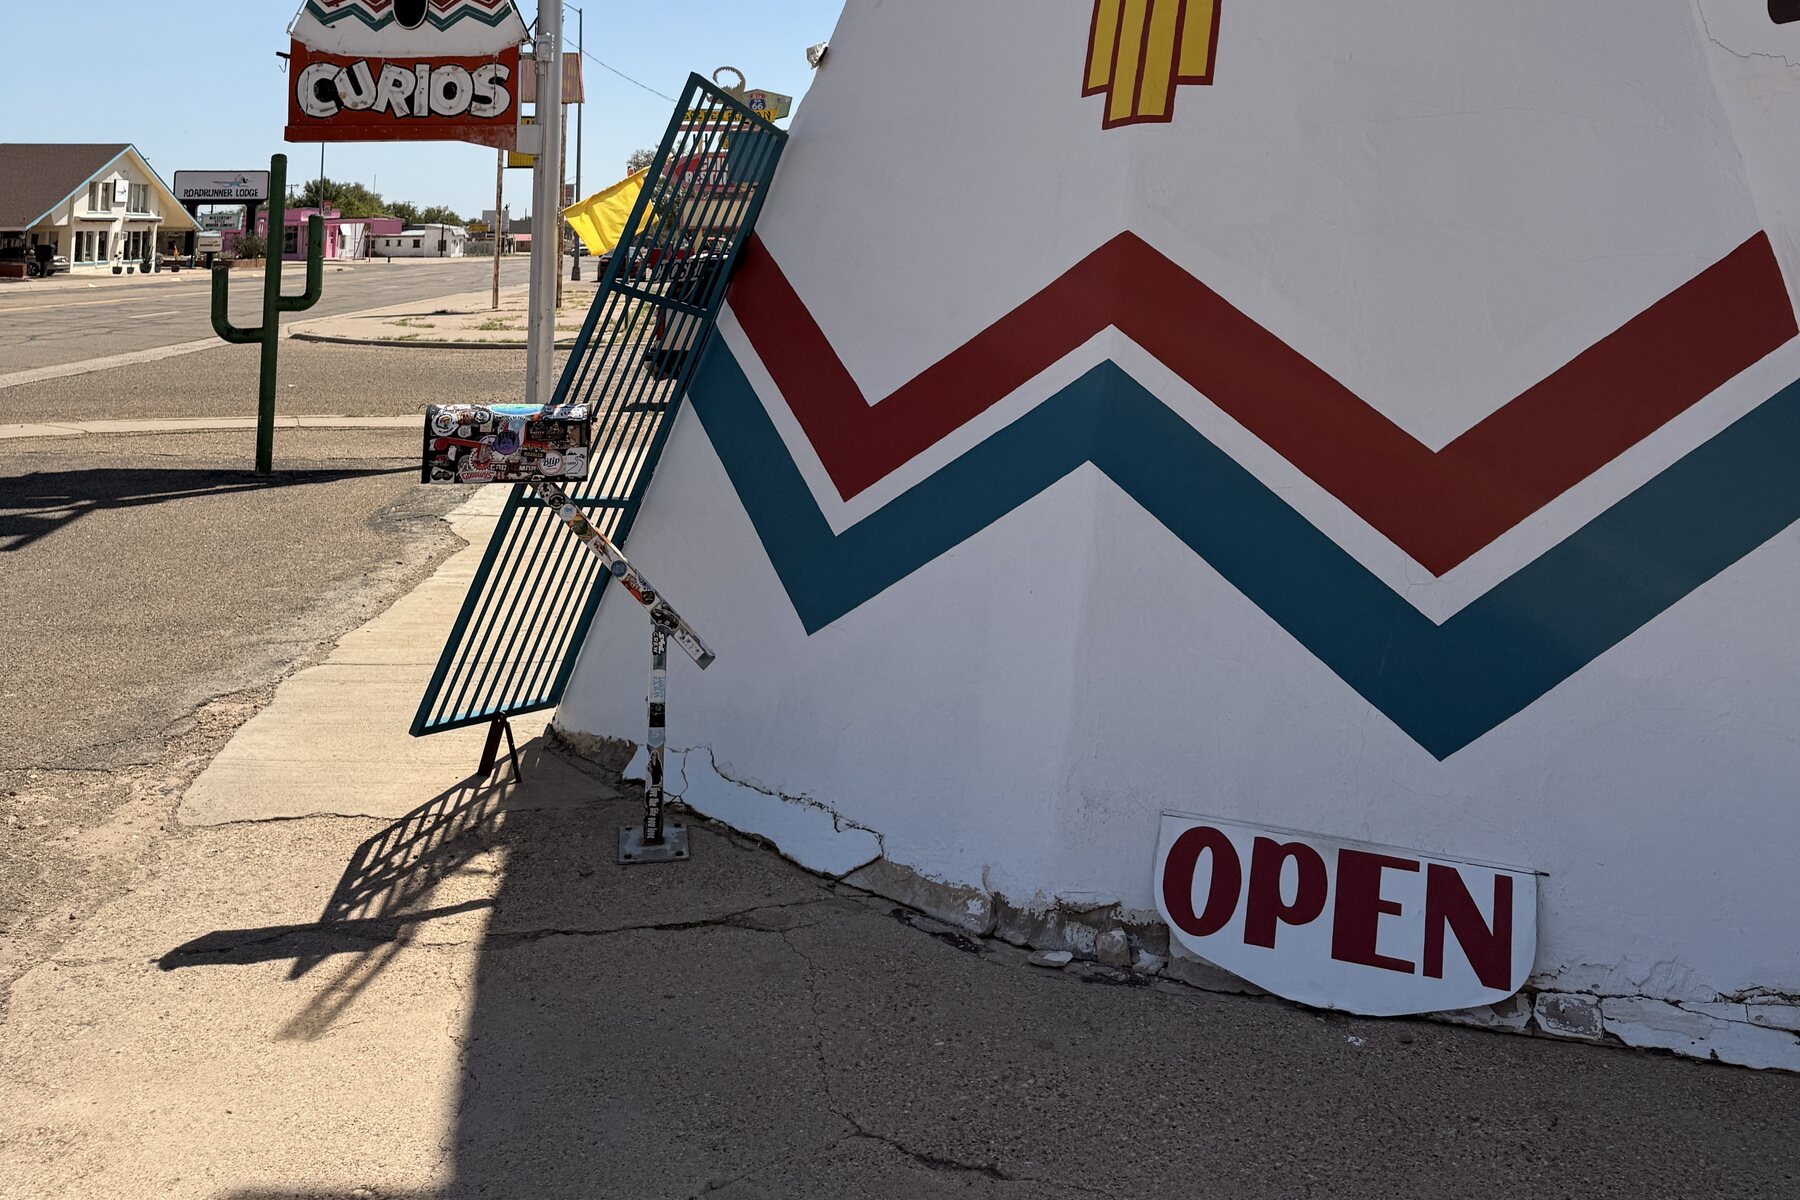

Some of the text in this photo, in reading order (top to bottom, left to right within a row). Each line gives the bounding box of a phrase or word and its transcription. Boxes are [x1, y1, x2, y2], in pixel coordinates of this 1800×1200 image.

[296, 60, 512, 119] CURIOS
[751, 102, 764, 110] 66
[183, 188, 259, 198] ROADRUNNER LODGE
[543, 456, 560, 468] Blip
[1162, 826, 1513, 992] OPEN
